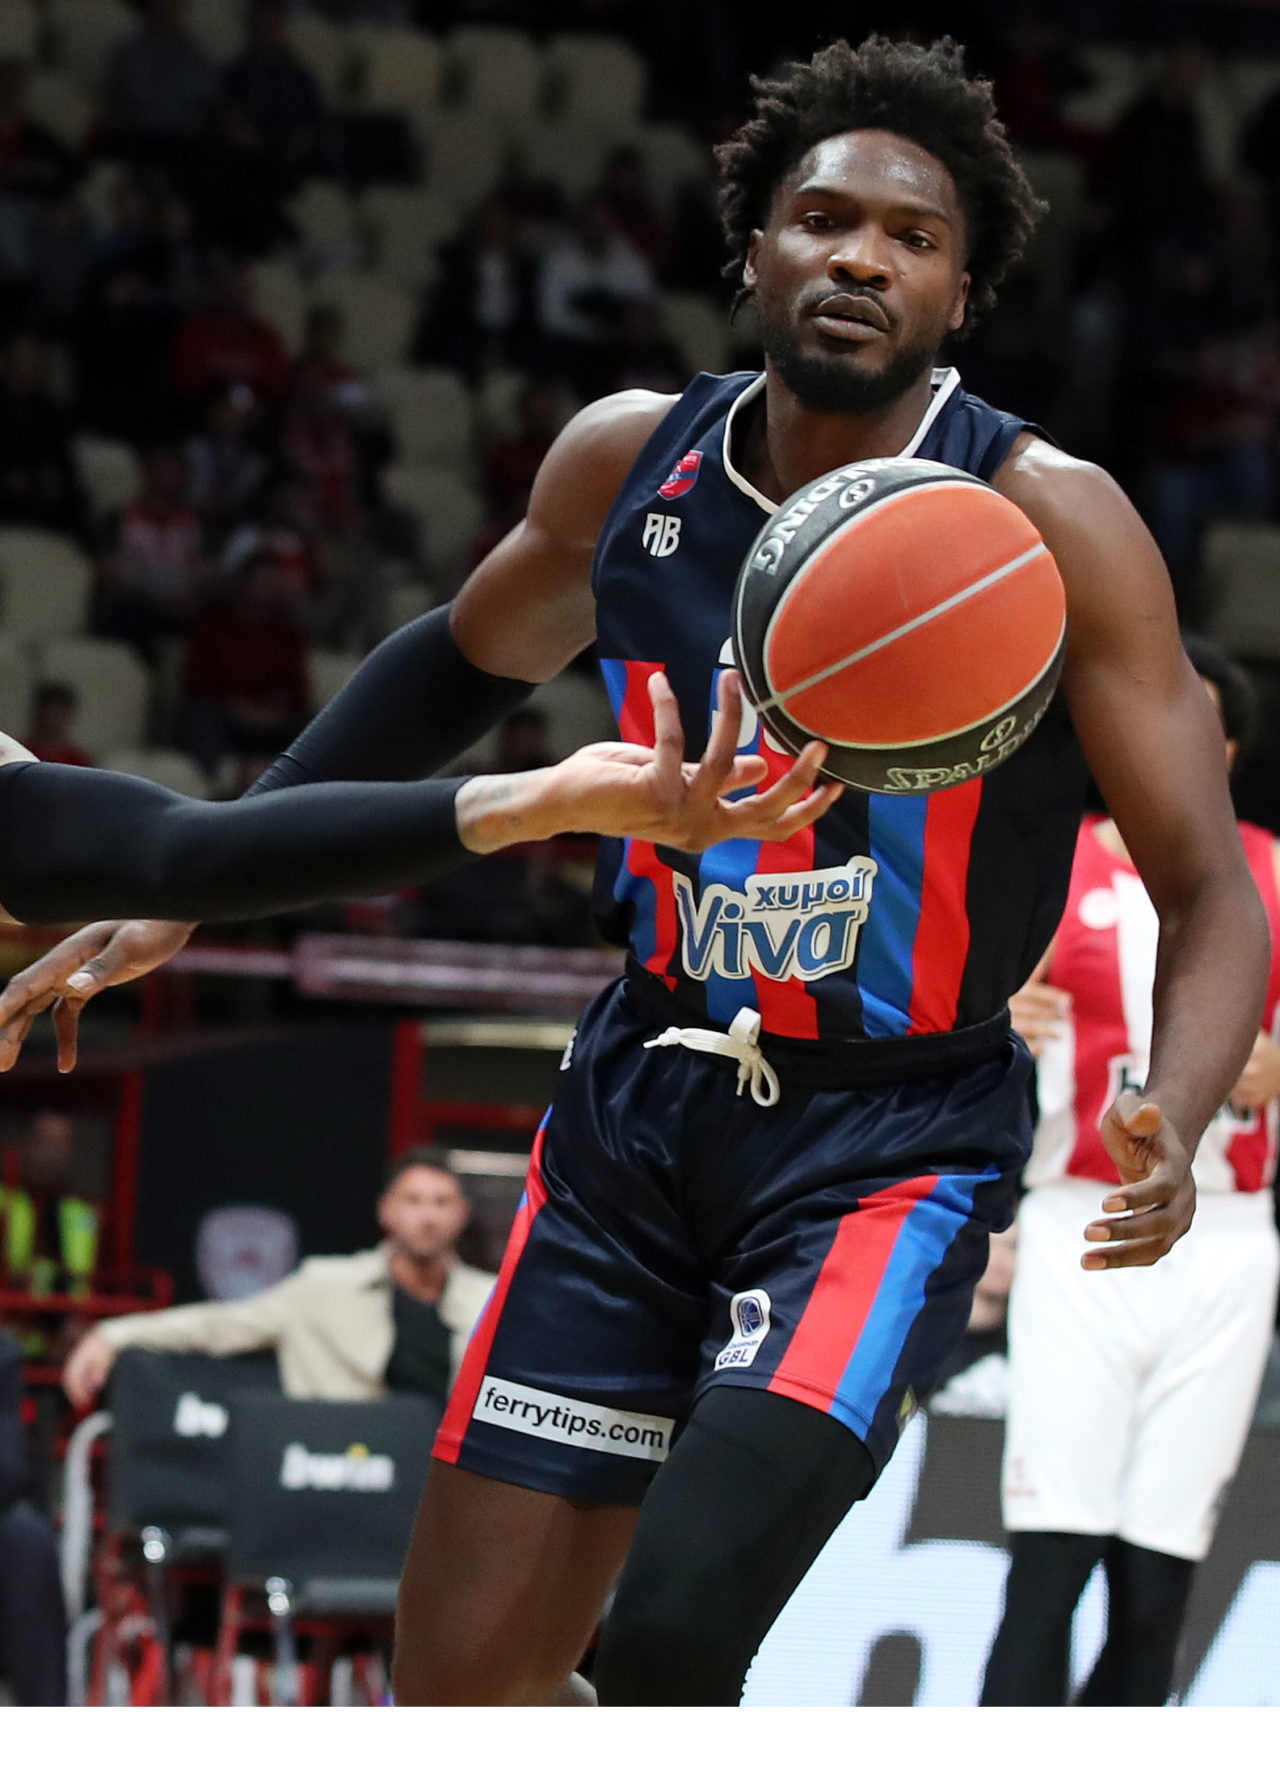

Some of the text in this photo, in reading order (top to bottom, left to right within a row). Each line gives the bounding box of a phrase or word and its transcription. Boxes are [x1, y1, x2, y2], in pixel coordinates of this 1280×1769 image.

[675, 883, 859, 978] Viva
[719, 1349, 748, 1366] GBL
[484, 1387, 665, 1448] ferrytips.com
